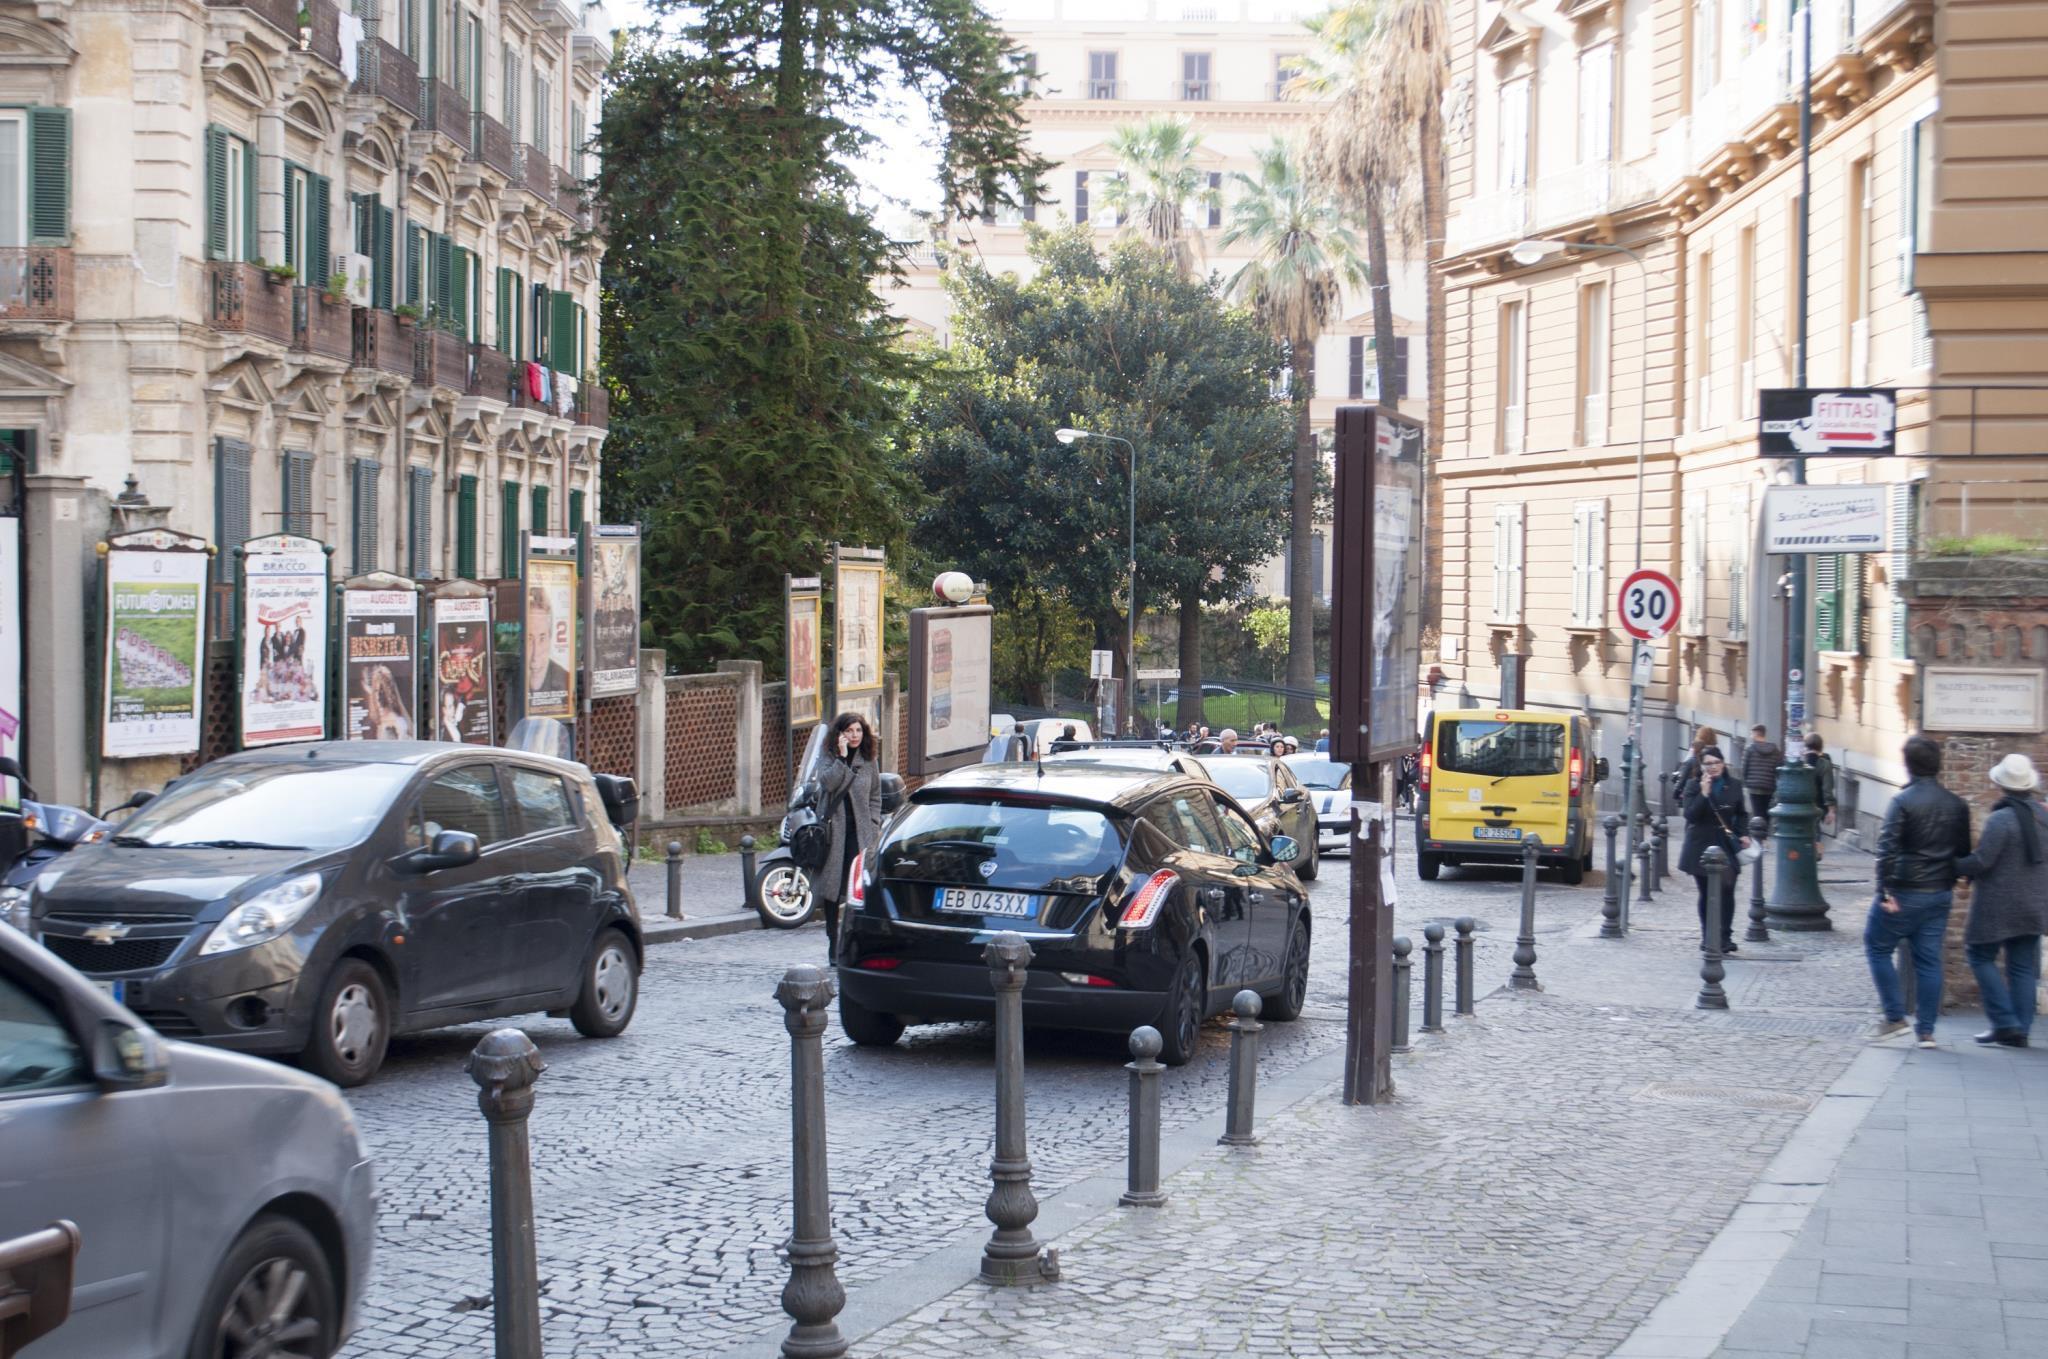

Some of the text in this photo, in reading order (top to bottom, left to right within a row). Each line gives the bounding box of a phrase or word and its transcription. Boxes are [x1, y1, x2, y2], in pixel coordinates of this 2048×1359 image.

[1818, 401, 1879, 419] FITTASI
[263, 562, 307, 571] BRACCO
[1630, 588, 1666, 620] 30
[556, 621, 567, 643] 2
[350, 635, 409, 657] BISBETICA
[945, 890, 1026, 914] EB 043XX
